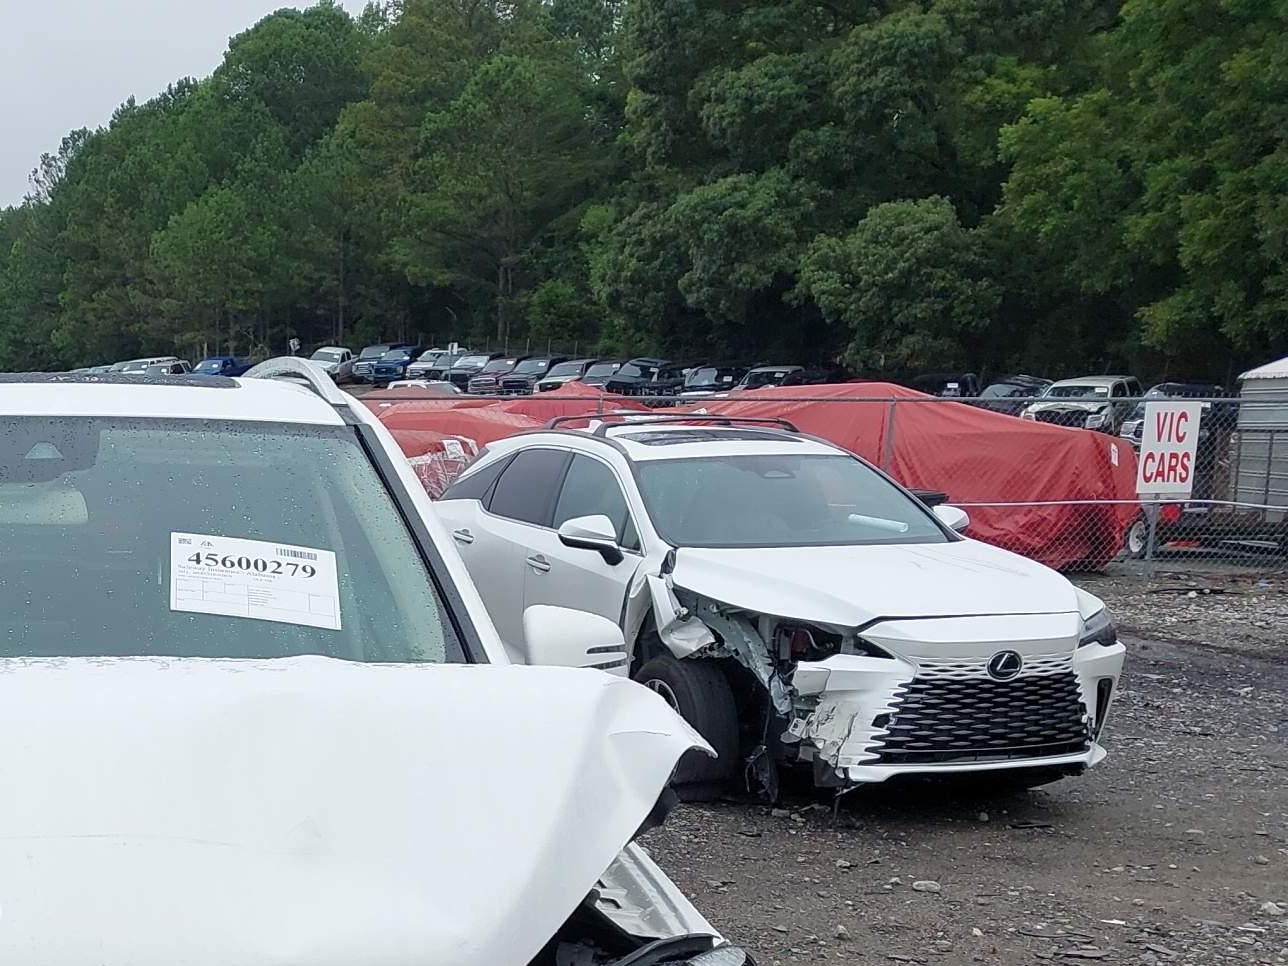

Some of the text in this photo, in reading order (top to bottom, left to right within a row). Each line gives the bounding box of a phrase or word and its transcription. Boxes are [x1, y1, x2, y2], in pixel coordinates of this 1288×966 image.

[1156, 411, 1189, 443] VIC
[1142, 451, 1191, 483] CARS
[188, 552, 316, 578] 45600279
